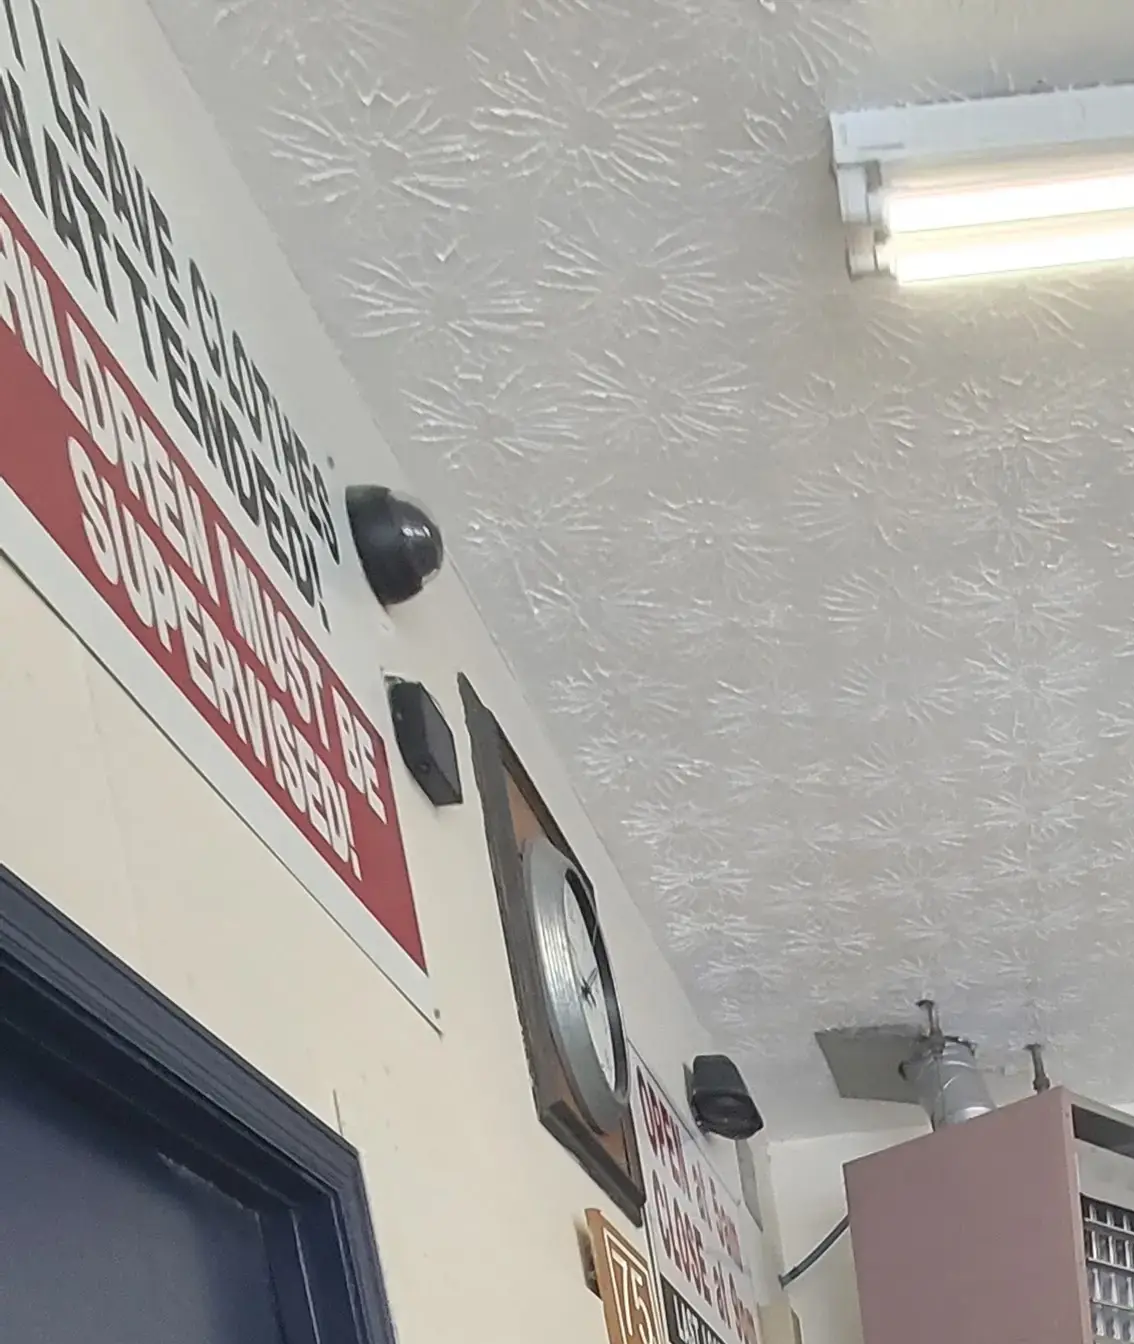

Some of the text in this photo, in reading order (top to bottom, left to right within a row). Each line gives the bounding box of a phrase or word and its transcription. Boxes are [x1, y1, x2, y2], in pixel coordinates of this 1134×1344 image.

[0, 67, 331, 634] NATTENDED!
[0, 215, 387, 825] HILDREN MUST BE
[31, 0, 340, 566] LEAVE CLOTHES
[67, 435, 362, 882] SUPERVISED!
[636, 1064, 692, 1203] OPEN
[652, 1168, 713, 1308] CLOSE
